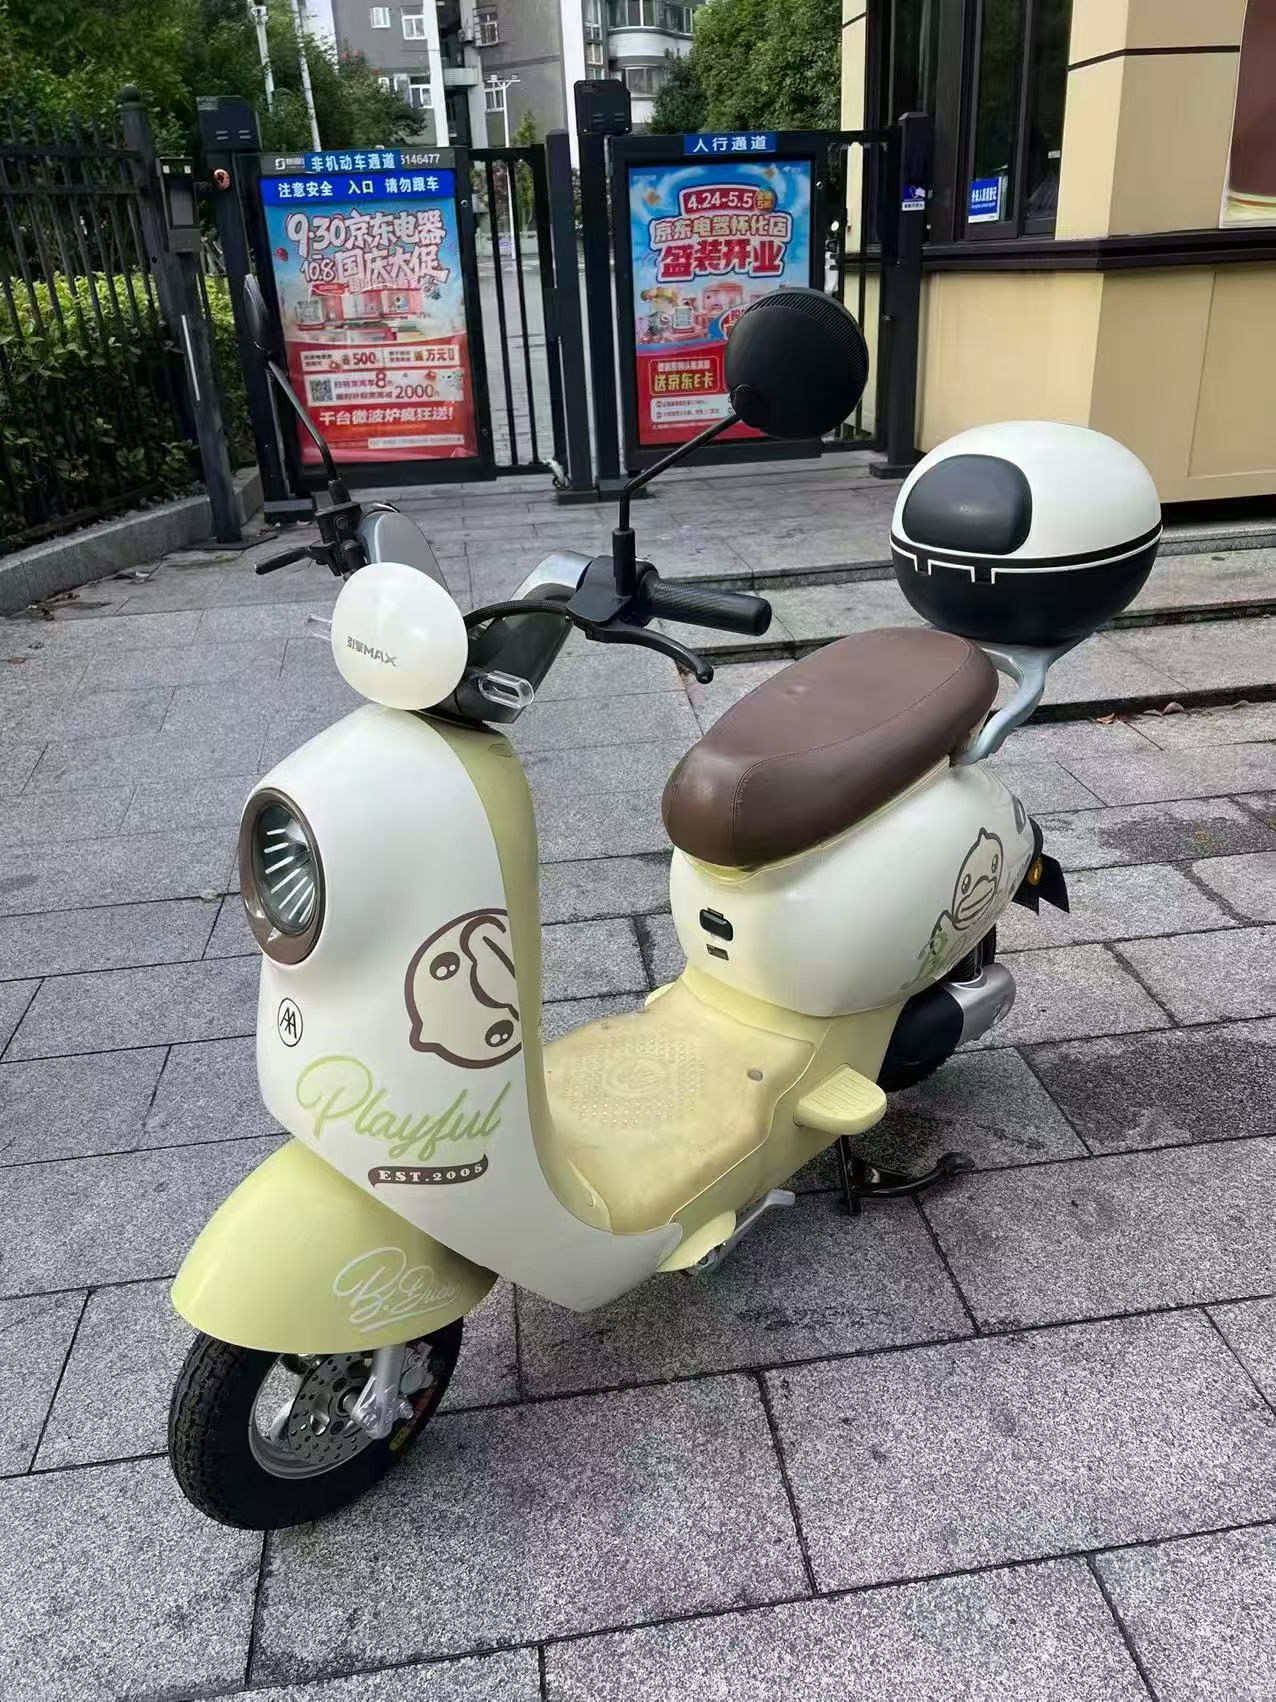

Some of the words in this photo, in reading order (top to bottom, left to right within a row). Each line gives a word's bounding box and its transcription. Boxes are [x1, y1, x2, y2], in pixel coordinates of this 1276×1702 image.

[693, 135, 767, 153] 人行通道
[311, 153, 396, 172] 非机动车通道
[277, 181, 333, 198] 注意安全
[348, 180, 373, 194] 入口
[384, 176, 439, 193] 请勿跟车
[687, 191, 753, 209] 4.24-5.5
[654, 213, 788, 243] 京东电器怀化店
[660, 238, 783, 278] 盛装开业
[296, 1056, 511, 1160] Playful
[377, 1163, 484, 1182] EST.2005
